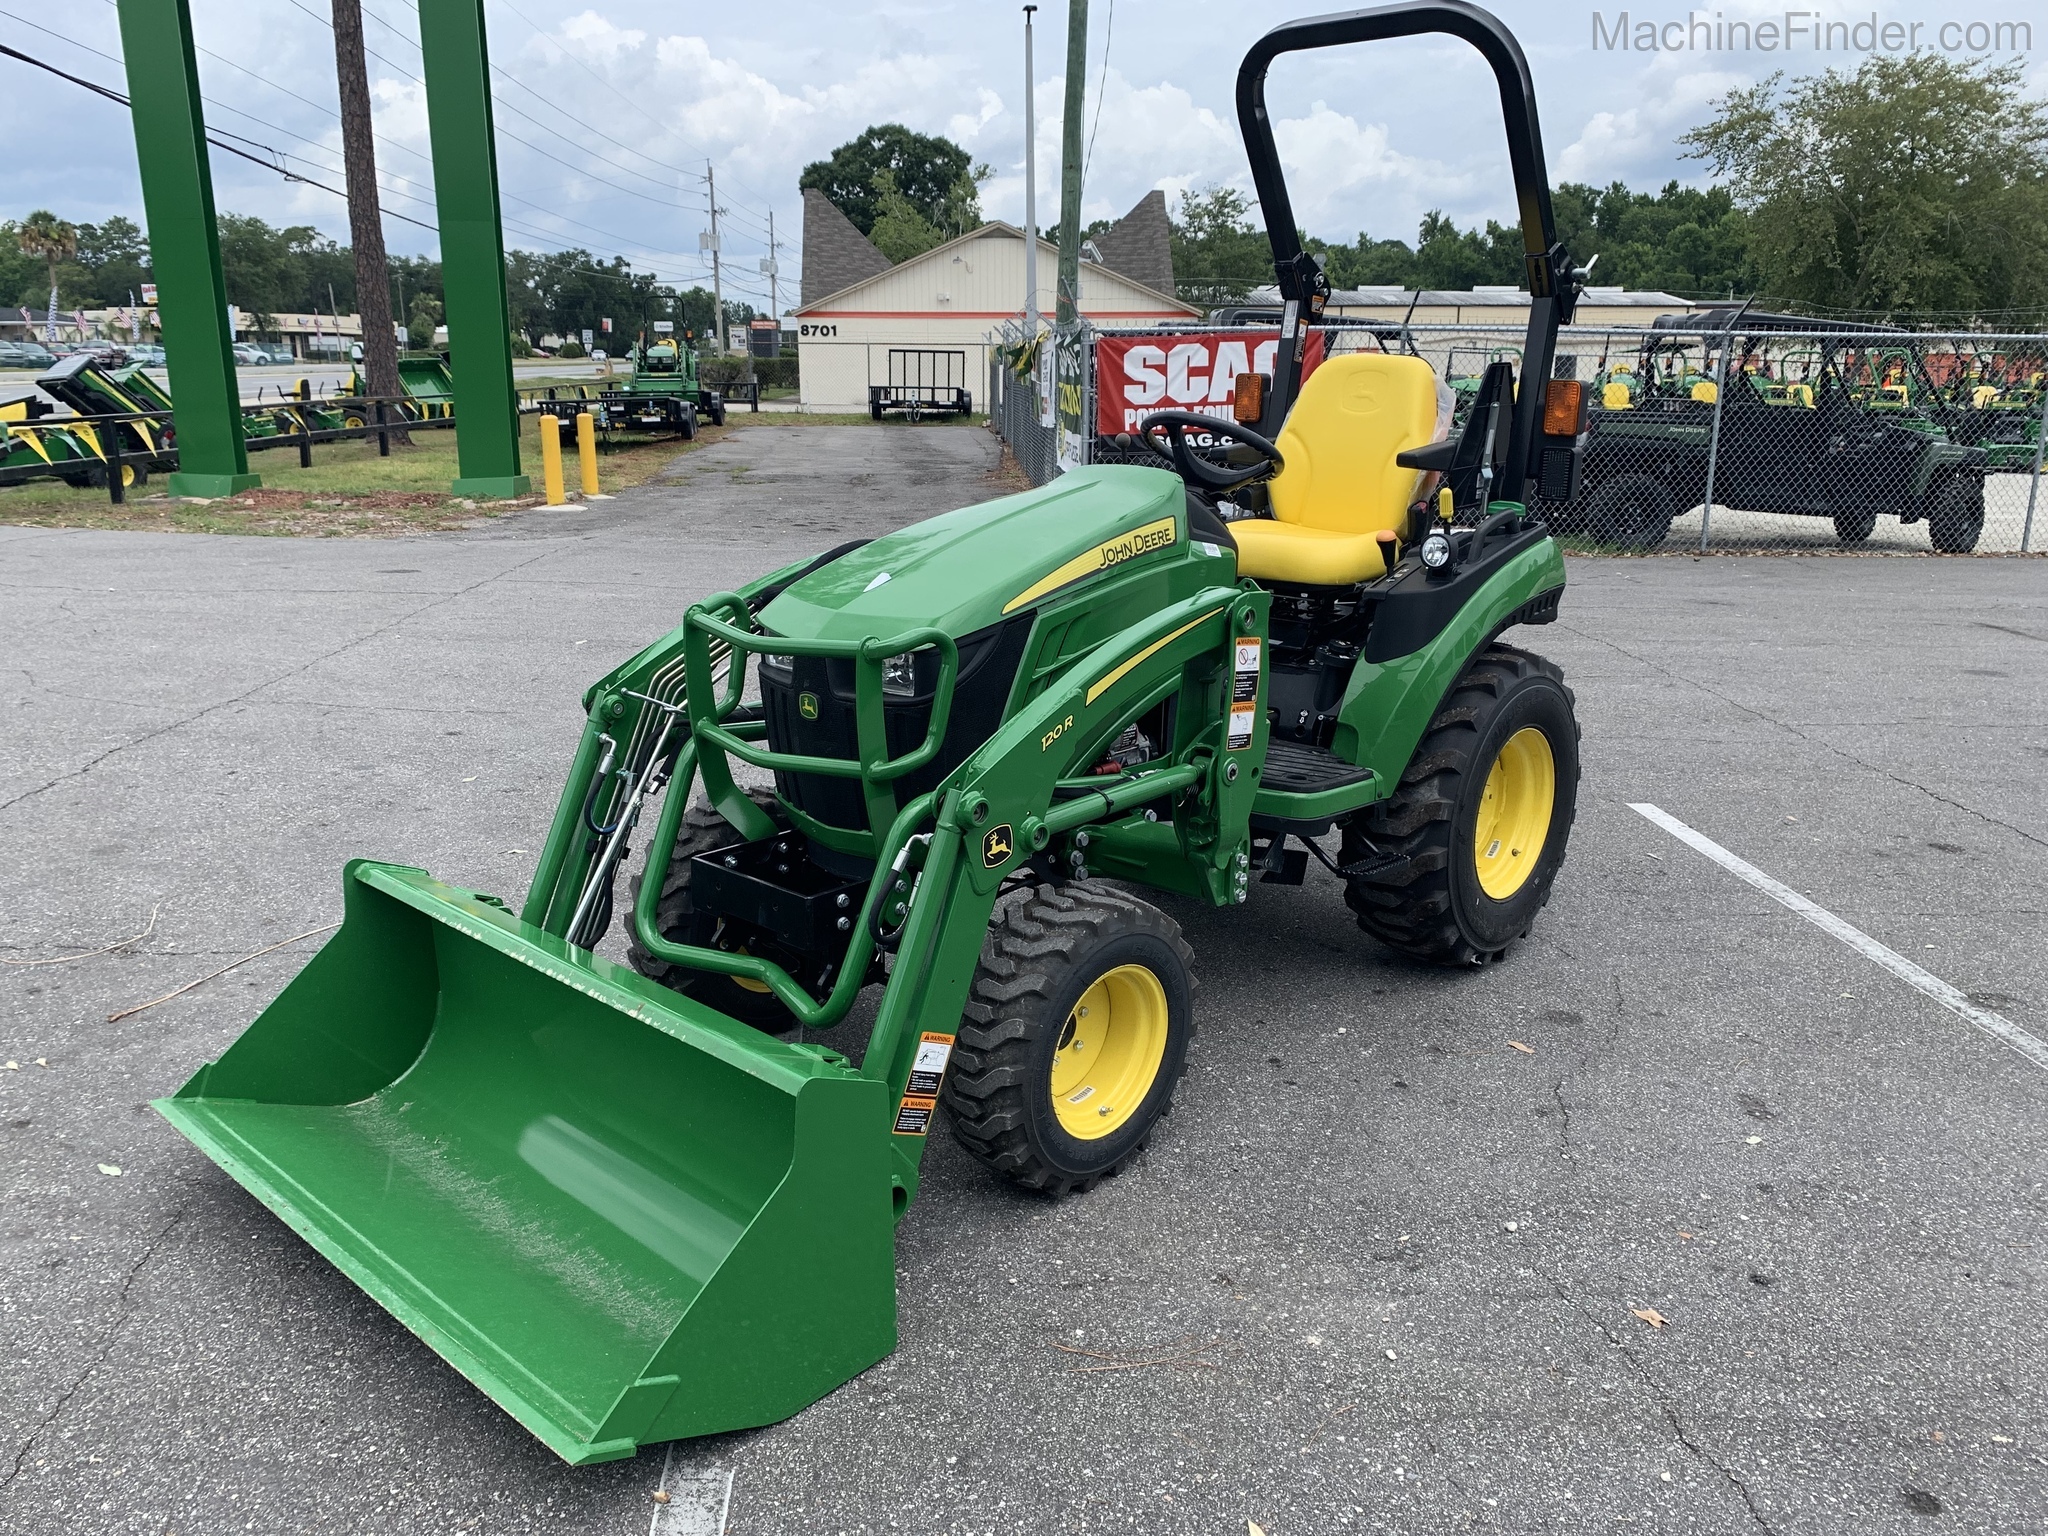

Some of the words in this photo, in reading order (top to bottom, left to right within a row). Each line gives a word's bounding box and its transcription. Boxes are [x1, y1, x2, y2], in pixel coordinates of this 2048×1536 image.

[801, 325, 837, 336] 8701
[1100, 541, 1133, 567] JOHN
[1133, 528, 1172, 552] DEERE
[930, 1035, 951, 1043] WARNING
[910, 1100, 932, 1108] WARNING
